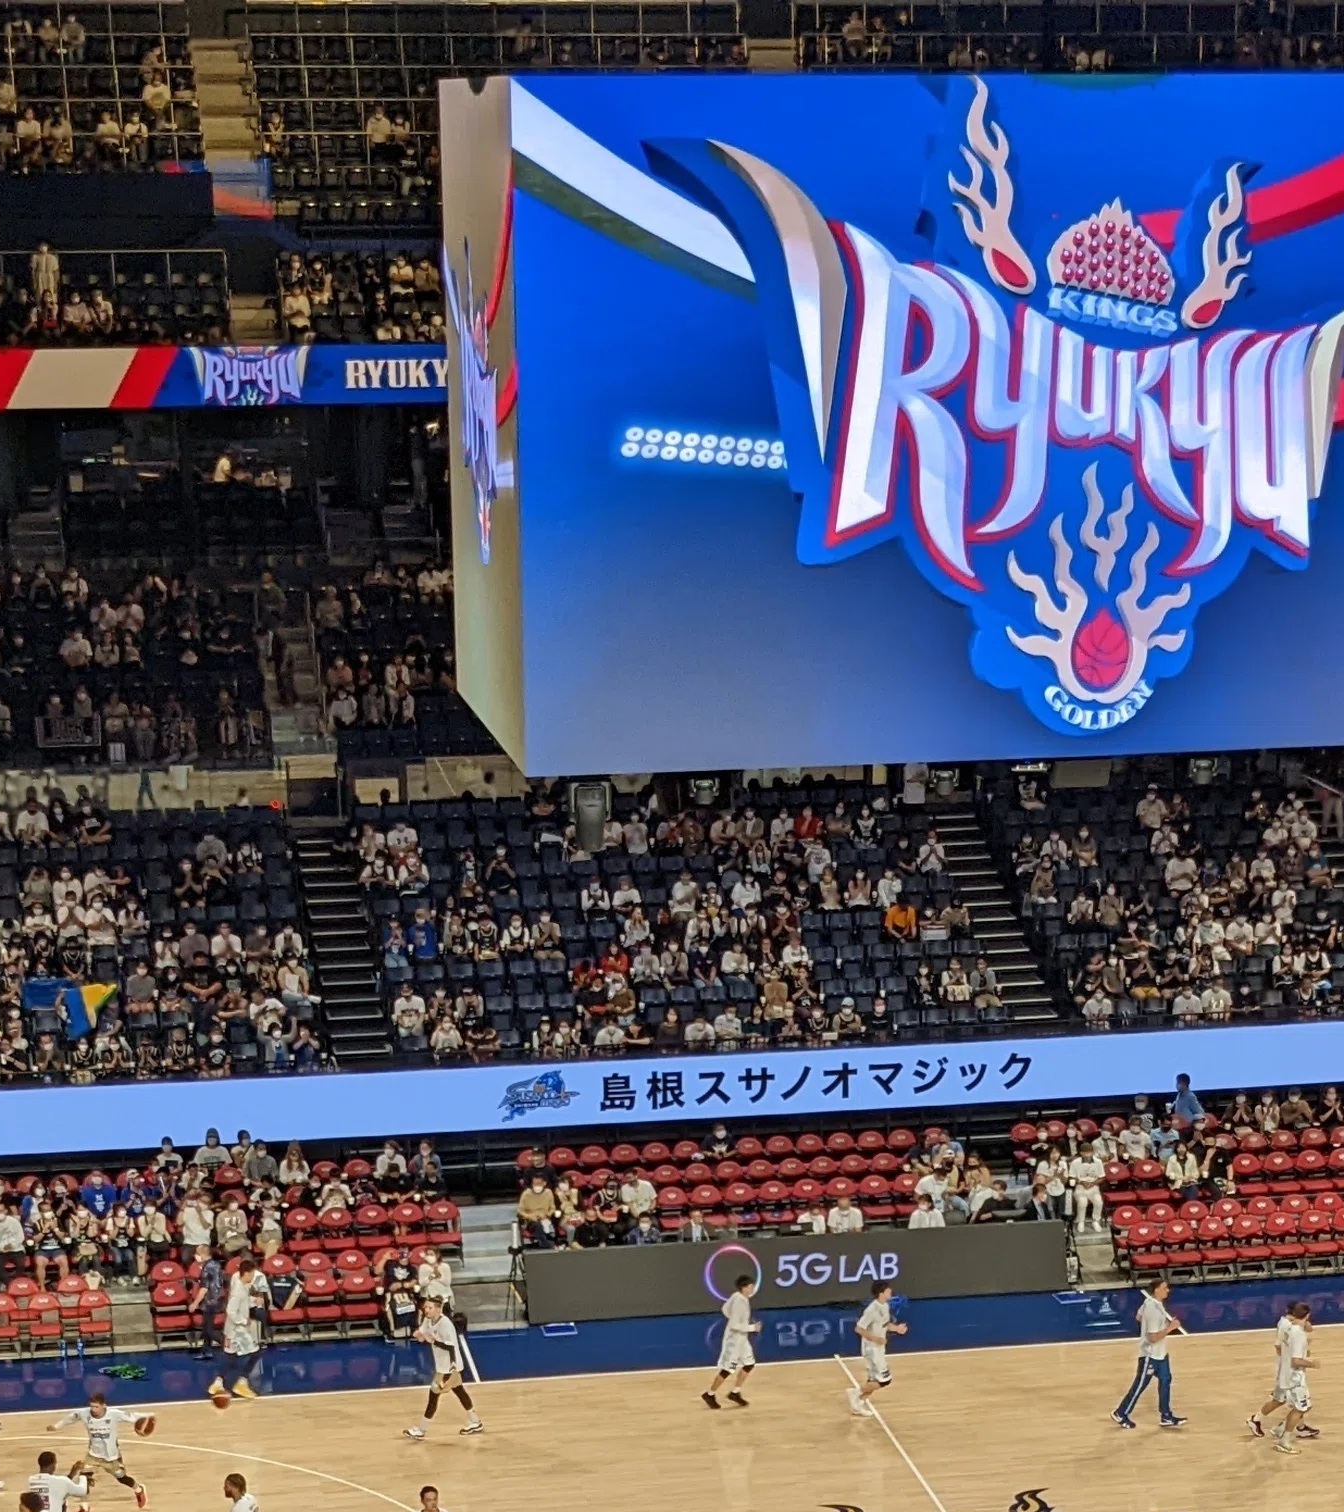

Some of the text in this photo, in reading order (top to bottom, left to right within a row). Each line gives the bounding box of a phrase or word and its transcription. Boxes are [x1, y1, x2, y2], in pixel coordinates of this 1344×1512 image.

[1046, 287, 1178, 338] KINGS
[344, 359, 449, 389] RYUKY
[1043, 679, 1154, 730] GOLDEN
[598, 1052, 1034, 1112] 島根スサノオマジック
[775, 1252, 899, 1287] 5G LAB
